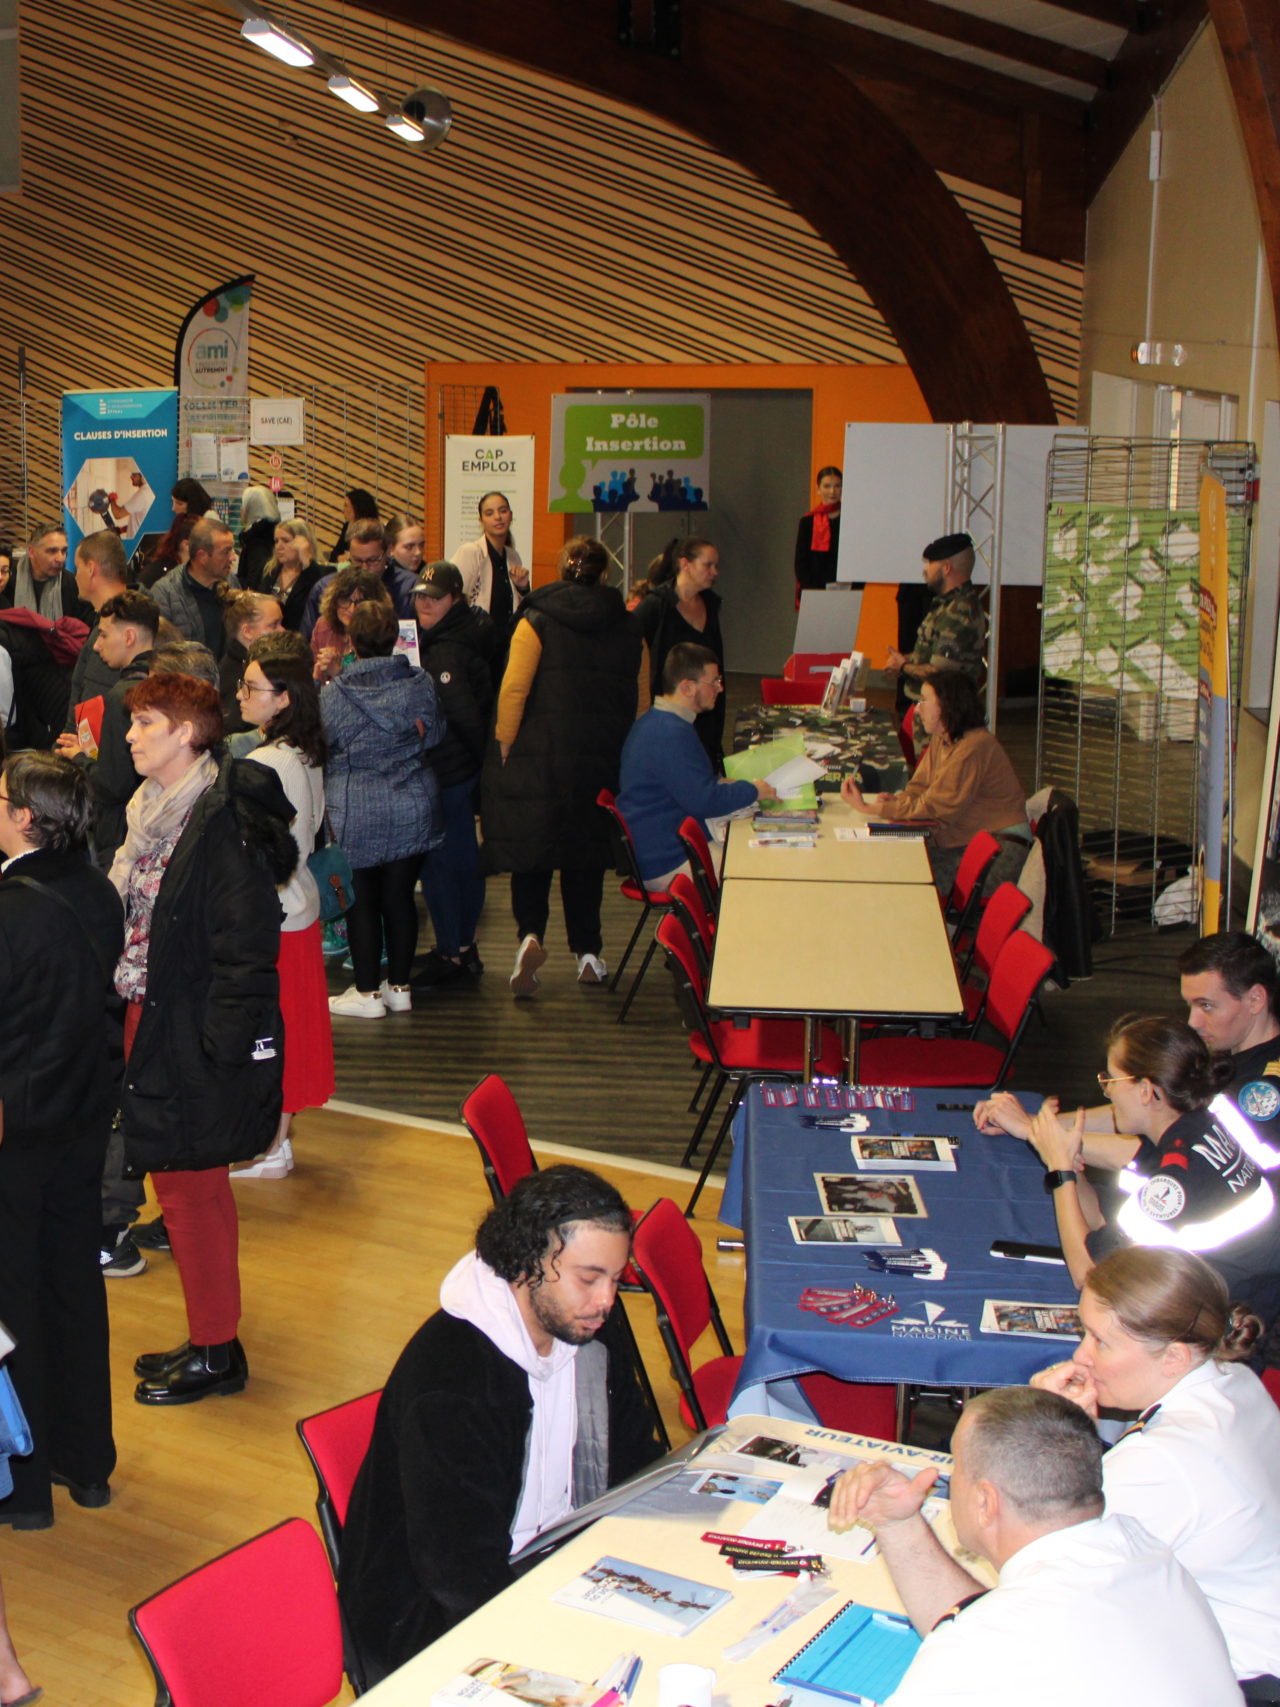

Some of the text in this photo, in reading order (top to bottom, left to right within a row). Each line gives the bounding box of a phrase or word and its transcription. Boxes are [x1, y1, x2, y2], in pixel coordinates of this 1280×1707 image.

[196, 339, 228, 359] ami
[260, 417, 293, 425] SAVE (CAE)
[610, 413, 659, 428] Pôle
[74, 428, 168, 441] CLAUSES D'INSERTION
[585, 436, 687, 452] Insertion
[475, 448, 503, 460] CAP
[462, 460, 516, 472] EMPLOI
[891, 1325, 971, 1335] MARINE
[892, 1331, 973, 1342] NATIONALE
[804, 1428, 956, 1465] IR-AVIATEUR
